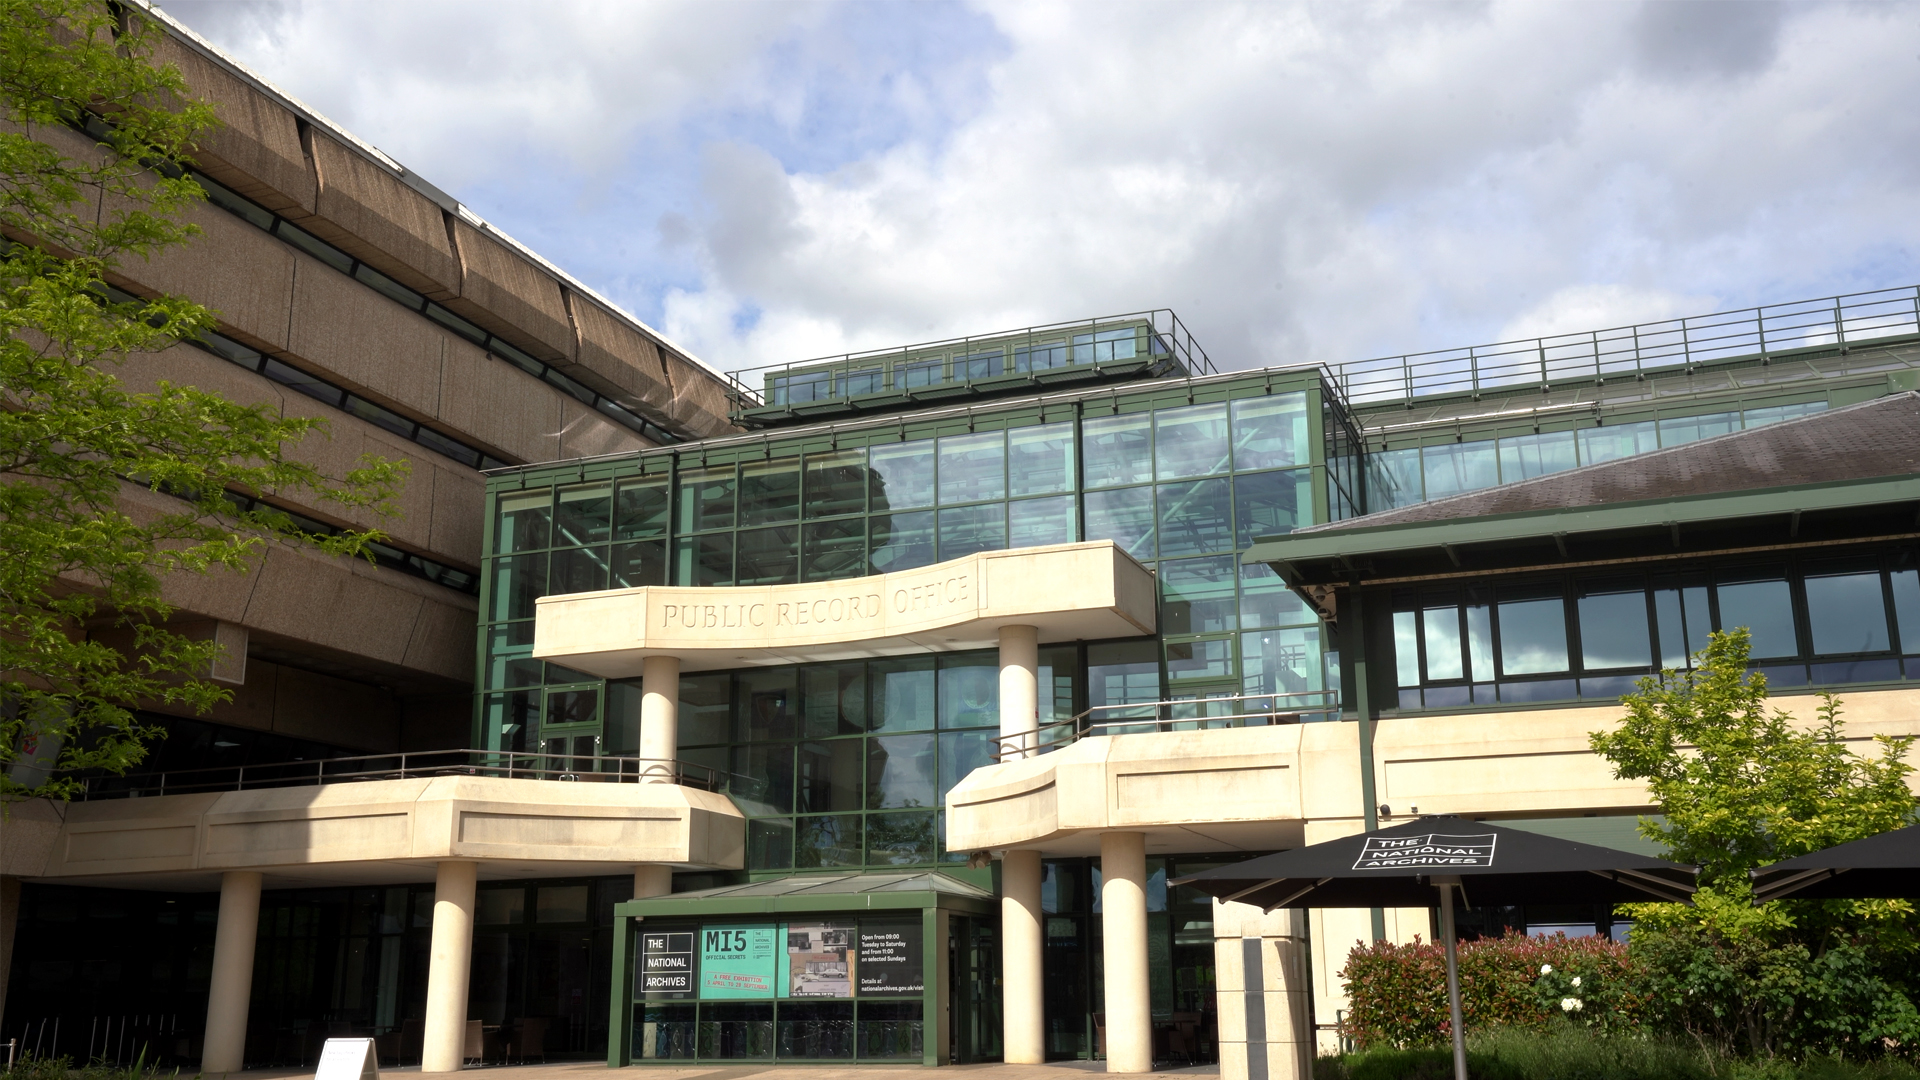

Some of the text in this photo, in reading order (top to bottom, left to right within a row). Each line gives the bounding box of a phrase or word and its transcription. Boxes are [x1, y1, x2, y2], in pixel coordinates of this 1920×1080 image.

[662, 575, 968, 629] PUBLIC RECORD OFFICE
[1379, 838, 1419, 847] THE
[1372, 847, 1482, 858] NATIONAL
[1366, 857, 1477, 866] ARCHIVES
[648, 939, 663, 948] THE
[706, 930, 746, 952] MI5
[648, 958, 686, 967] NATIONAL
[646, 977, 685, 986] ARCHIVES
